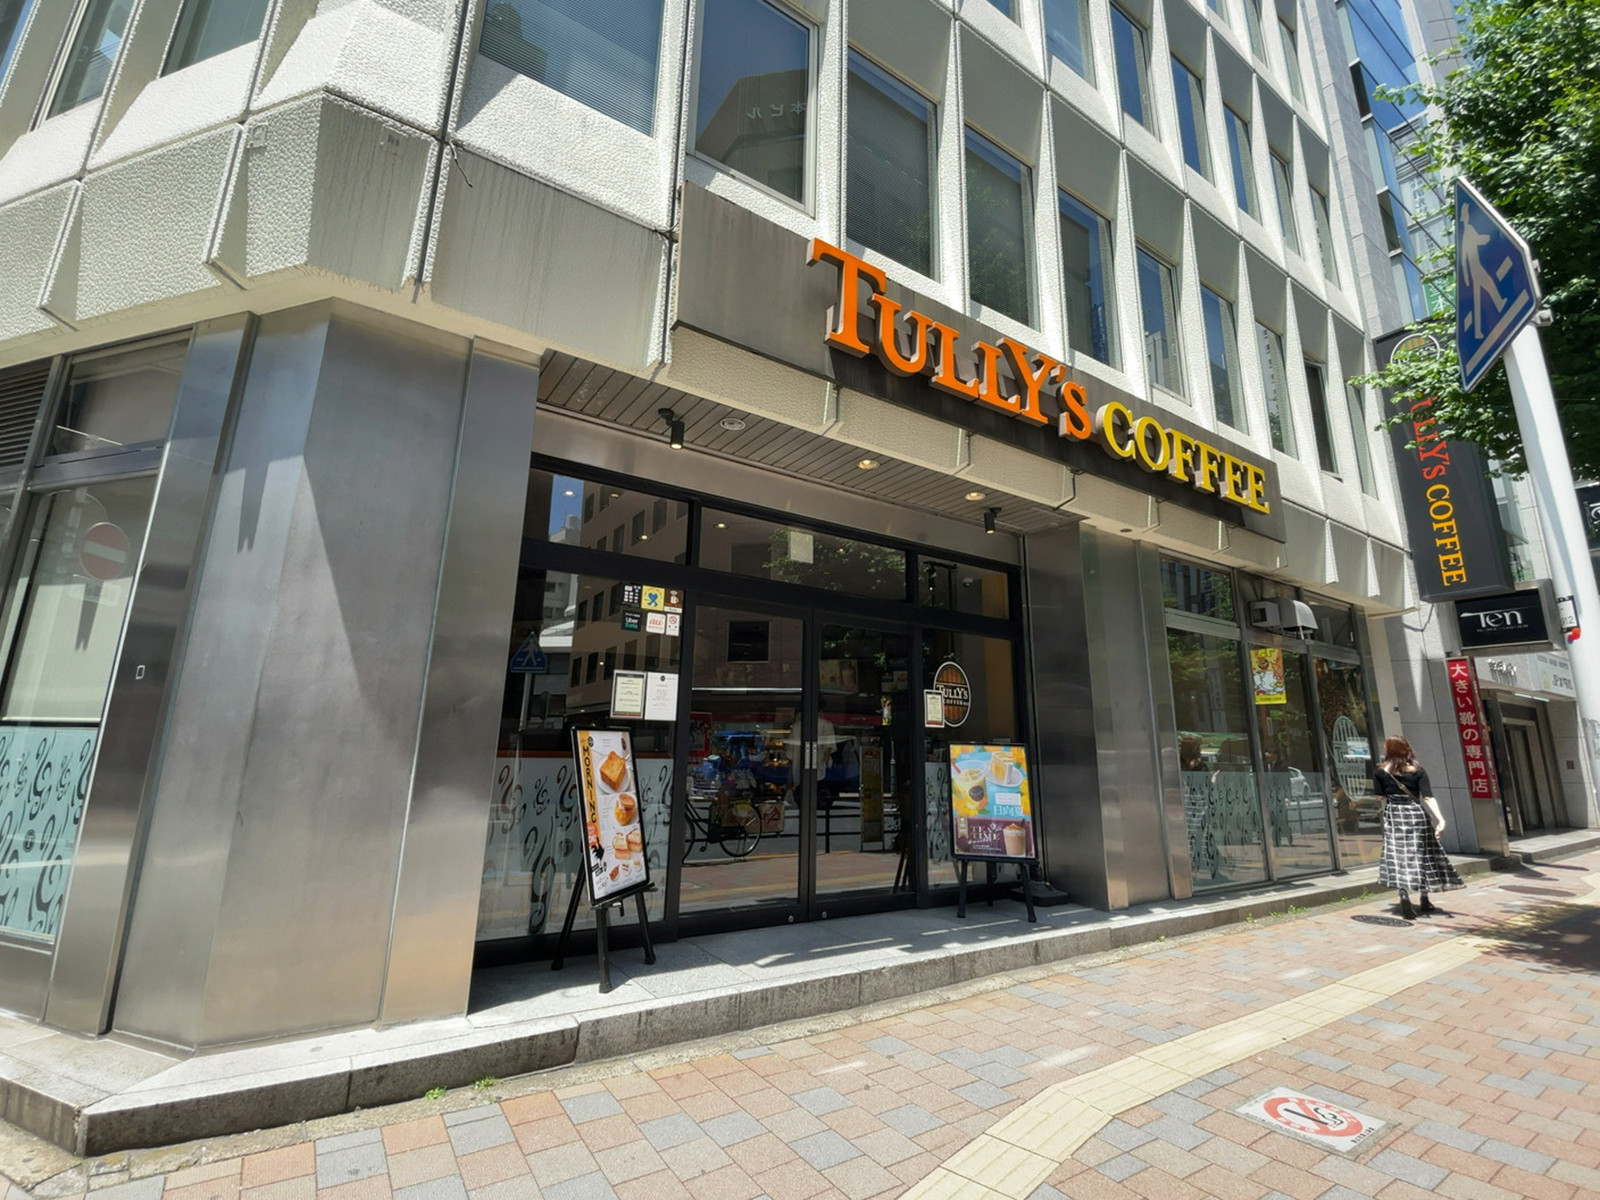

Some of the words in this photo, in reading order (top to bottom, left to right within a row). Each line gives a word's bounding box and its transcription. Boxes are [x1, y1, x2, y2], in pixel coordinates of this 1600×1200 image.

[806, 238, 1092, 440] TULLY'S
[1098, 401, 1270, 515] COFFEE
[1426, 484, 1467, 586] COFFEE
[1460, 610, 1523, 628] Ten
[1449, 663, 1489, 793] 大きい靴の専門店
[582, 746, 597, 823] MORNING
